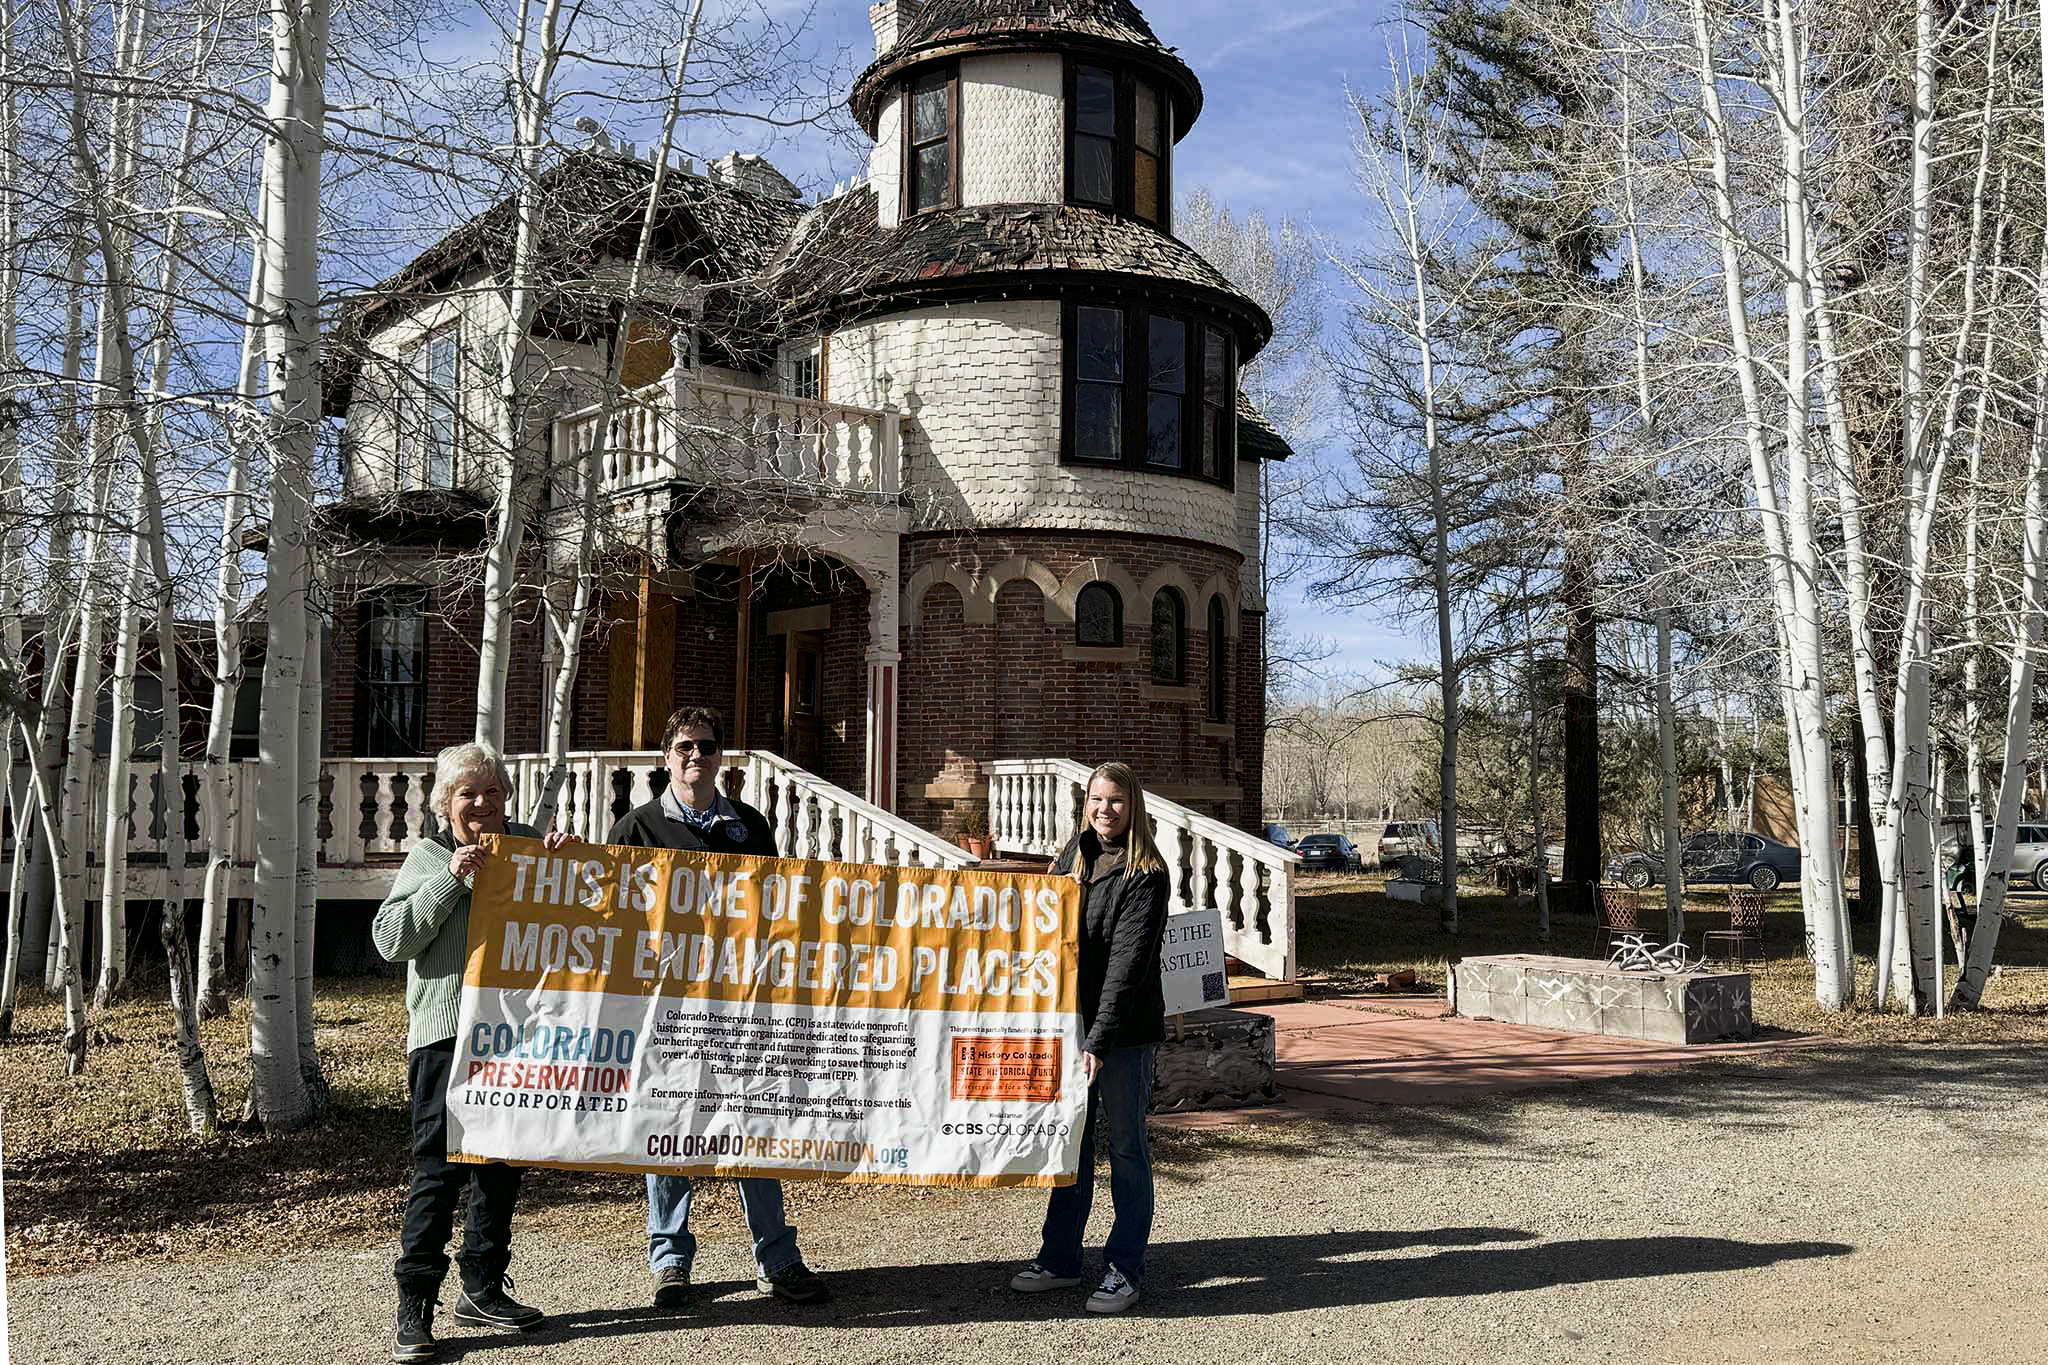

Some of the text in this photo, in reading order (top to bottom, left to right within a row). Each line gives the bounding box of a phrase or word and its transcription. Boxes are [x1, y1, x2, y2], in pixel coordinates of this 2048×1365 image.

[511, 854, 1058, 933] THIS IS ONE OF COLORADO'S
[1180, 923, 1212, 942] THE
[500, 921, 1058, 996] MOST ENDANGERED PLACES
[666, 1010, 707, 1021] Colorado
[768, 1016, 784, 1027] Inc.
[785, 1017, 807, 1028] (CPI)
[808, 1018, 815, 1028] is
[823, 1020, 865, 1030] statewide
[867, 1022, 908, 1033] nonprofit
[471, 1023, 636, 1064] COLORADO
[656, 1022, 916, 1046] historic preservation organization dedicated to safeguarding
[653, 1036, 917, 1057] our heritage for current and future generations. This is one of
[978, 1050, 1053, 1060] History Colorado
[662, 1051, 683, 1059] over
[700, 1050, 735, 1062] historic
[736, 1053, 763, 1065] places
[764, 1054, 780, 1065] CPI
[781, 1055, 788, 1065] is
[790, 1056, 826, 1069] working
[828, 1059, 837, 1067] to
[838, 1060, 858, 1068] save
[859, 1059, 894, 1071] through
[895, 1060, 907, 1070] its
[467, 1060, 633, 1093] PRESERVATION
[710, 1064, 858, 1082] Endangered Places Program (EPP).
[1034, 1067, 1053, 1078] FUND
[465, 1089, 628, 1113] INCORPORATED
[651, 1088, 911, 1108] For more information on CPI and ongoing efforts to save this
[699, 1102, 716, 1112] and
[743, 1105, 794, 1119] community
[795, 1107, 843, 1120] landmarks,
[845, 1109, 864, 1120] visit
[955, 1123, 1069, 1137] CBS COLORADO
[646, 1134, 909, 1169] COLORADOPRESERVATION.org
